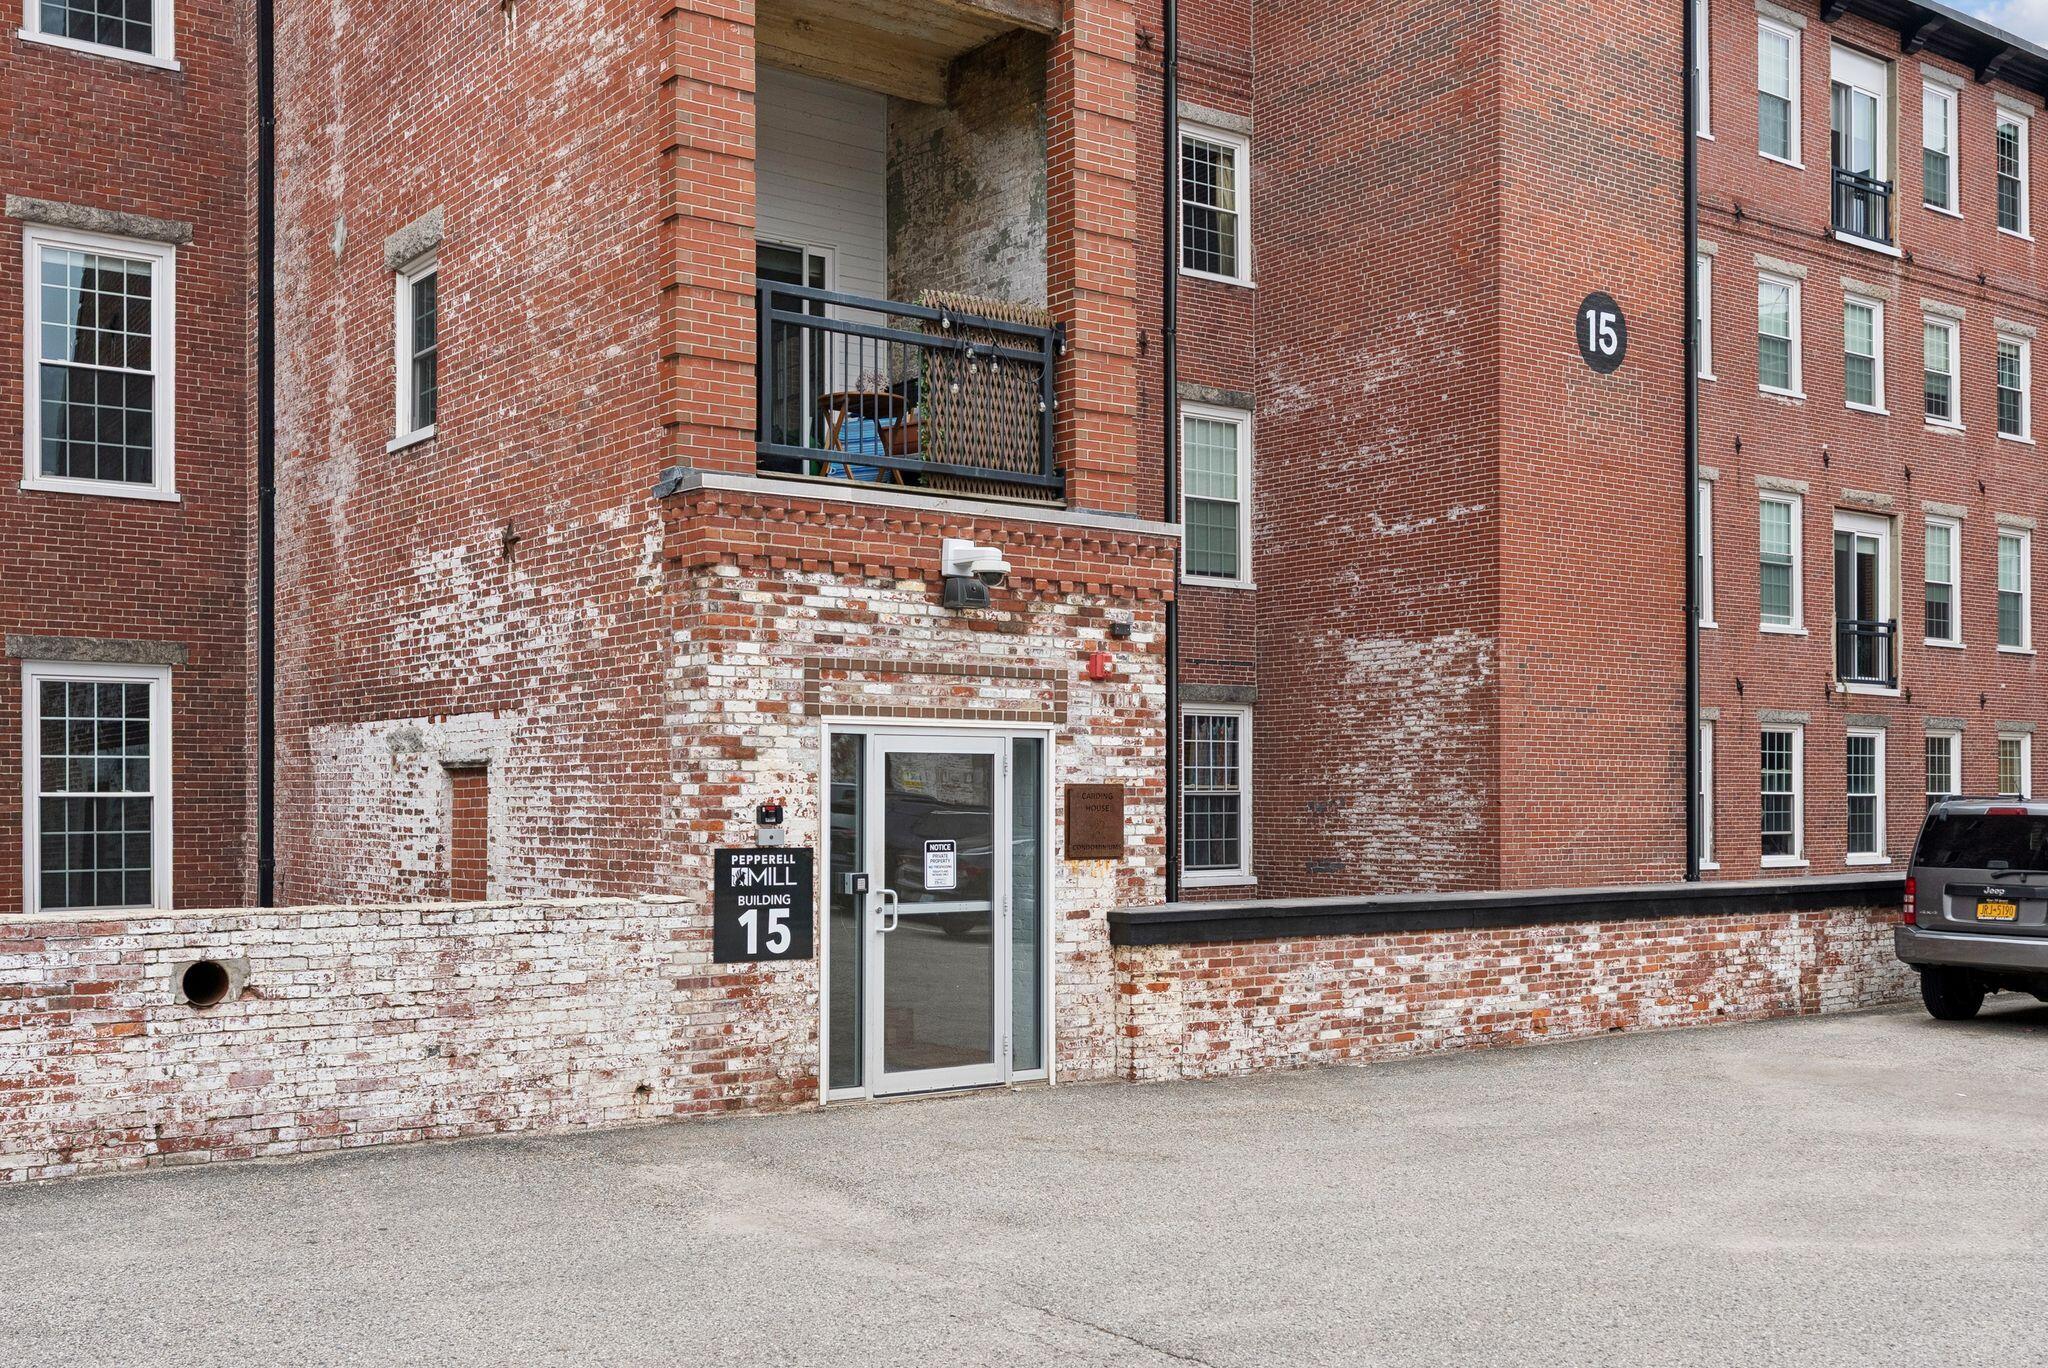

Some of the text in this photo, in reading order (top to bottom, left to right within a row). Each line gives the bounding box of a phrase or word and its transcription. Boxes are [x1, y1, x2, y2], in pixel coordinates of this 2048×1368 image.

[1586, 309, 1618, 356] 15
[1081, 792, 1114, 800] CARDING
[1086, 804, 1110, 812] HOUSE
[929, 843, 951, 851] NOTICE
[731, 854, 796, 865] PEPPERELL
[748, 866, 798, 886] MILL
[1983, 886, 2006, 896] Jeep
[738, 894, 791, 906] BUILDING
[737, 907, 792, 955] 15
